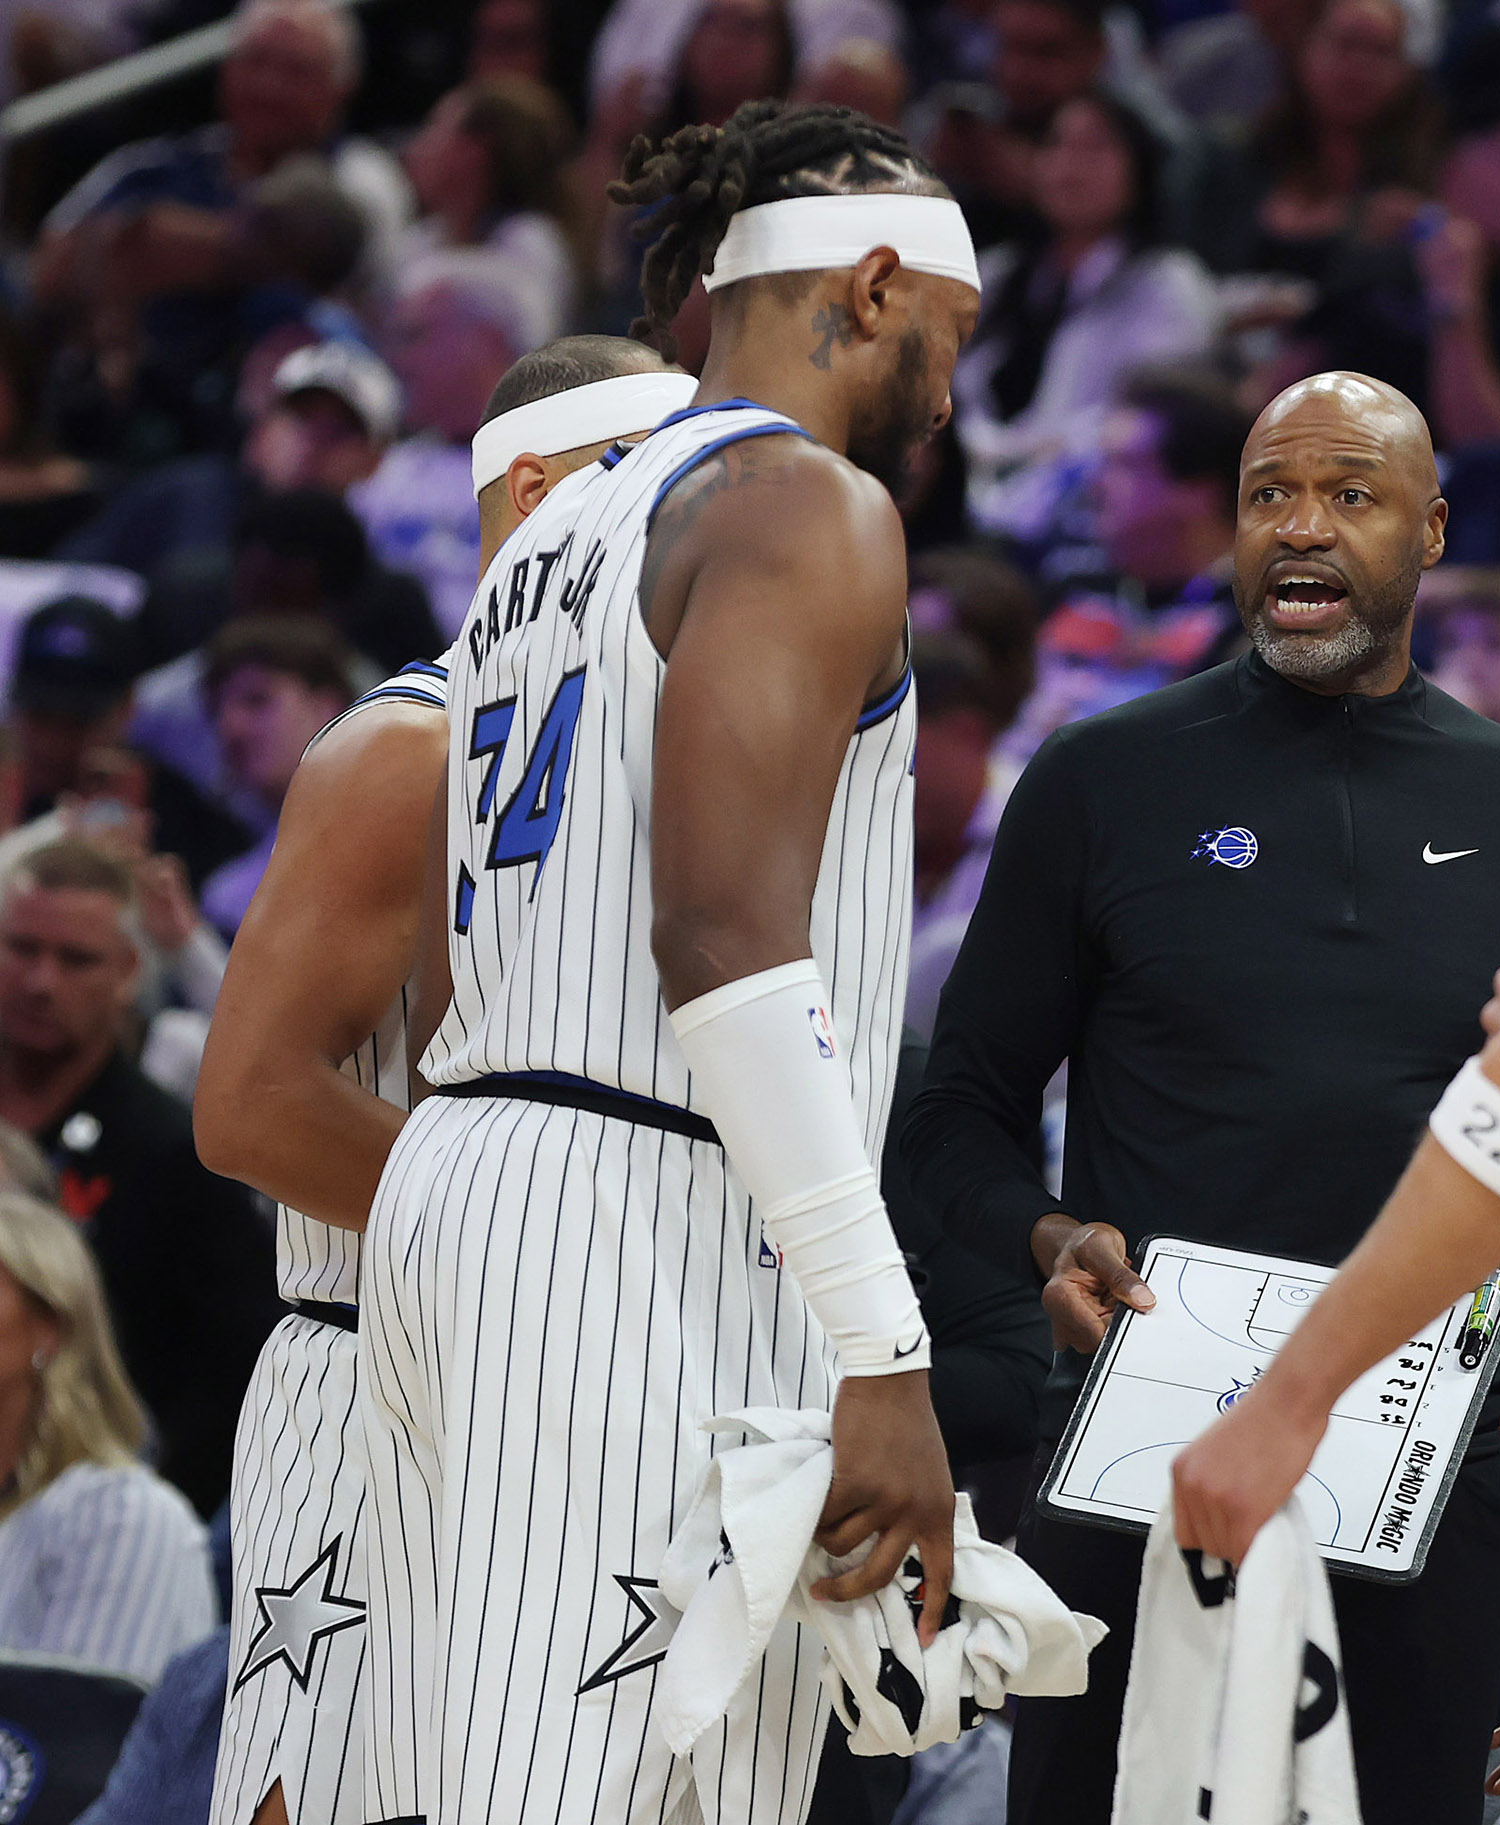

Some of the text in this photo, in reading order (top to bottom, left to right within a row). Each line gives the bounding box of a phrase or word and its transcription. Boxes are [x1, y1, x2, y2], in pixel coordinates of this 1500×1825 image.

[469, 535, 573, 676] CART
[1376, 1440, 1437, 1554] ORLANDO MAGIC
